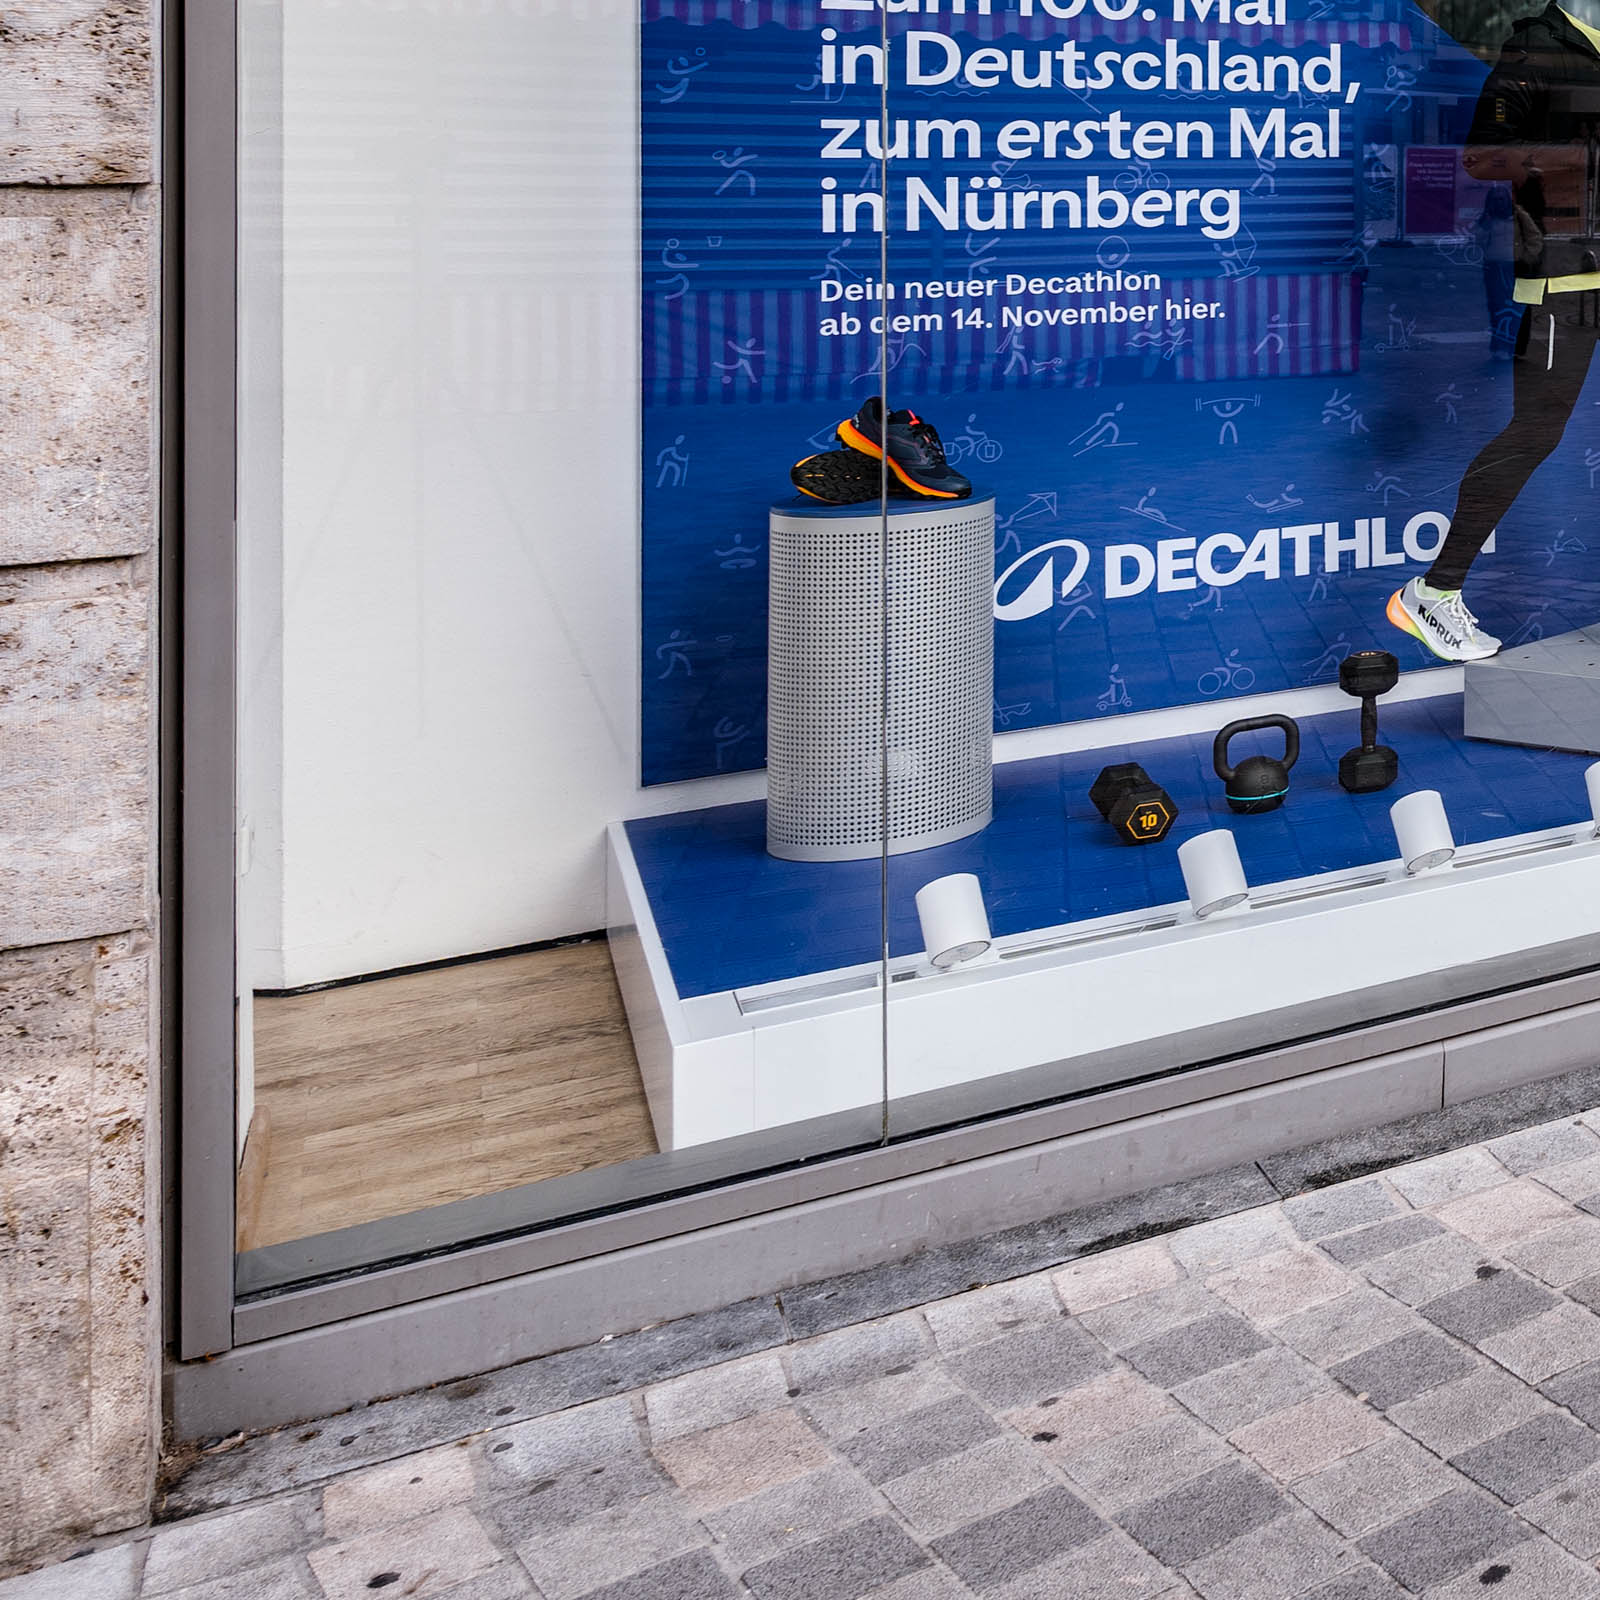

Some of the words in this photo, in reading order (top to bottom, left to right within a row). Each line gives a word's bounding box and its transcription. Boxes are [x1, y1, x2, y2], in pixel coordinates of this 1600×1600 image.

[821, 29, 886, 88] in
[907, 31, 1361, 104] Deutschland,
[820, 119, 981, 159] zum
[996, 110, 1213, 160] ersten
[1231, 107, 1340, 159] Mal
[821, 177, 886, 234] in
[907, 175, 1240, 240] Nürnberg
[820, 279, 895, 302] Dein
[904, 277, 998, 299] neuer
[1006, 269, 1161, 296] Decathlon
[819, 311, 861, 336] ab
[869, 308, 943, 334] dem
[951, 308, 993, 330] 14.
[1002, 301, 1159, 328] November
[1165, 299, 1226, 321] hier.
[1105, 511, 1496, 599] DECATHLO
[1139, 813, 1158, 828] 10
